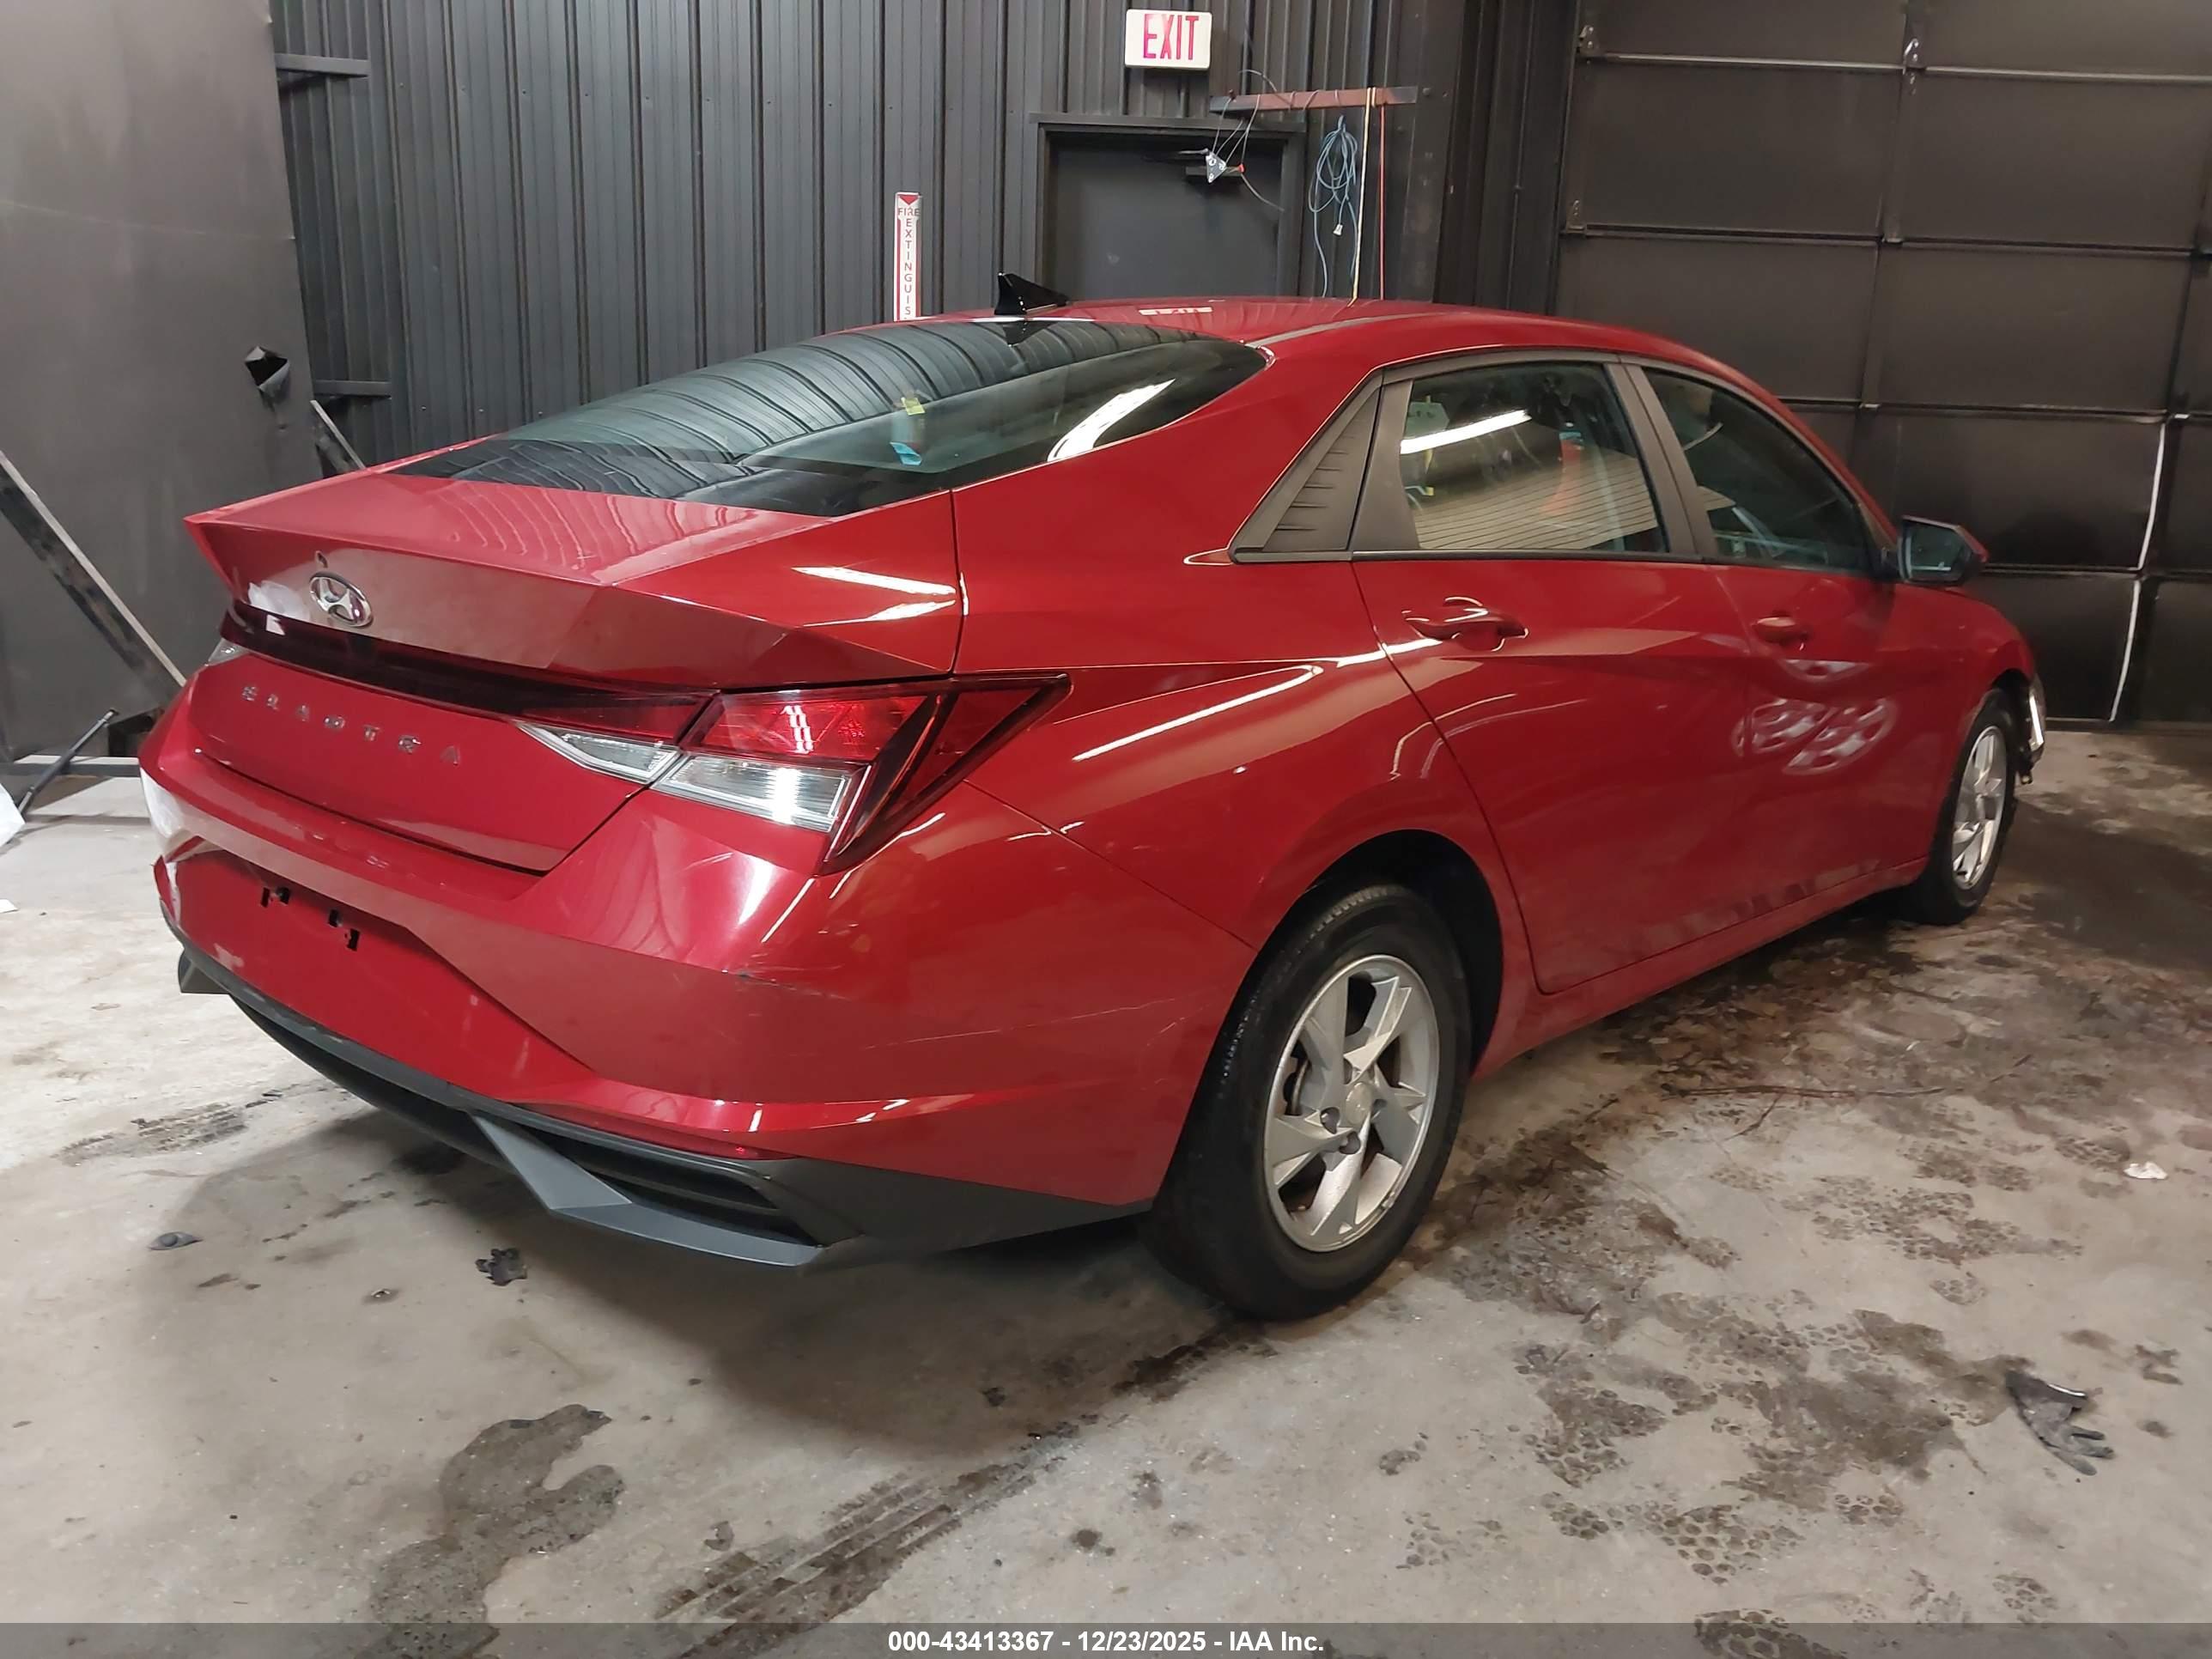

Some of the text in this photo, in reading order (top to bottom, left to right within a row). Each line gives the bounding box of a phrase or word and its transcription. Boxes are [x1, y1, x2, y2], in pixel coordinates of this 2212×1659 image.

[1143, 13, 1200, 60] EXIT
[897, 207, 921, 216] FIRE
[903, 218, 913, 319] EXTINGUIS
